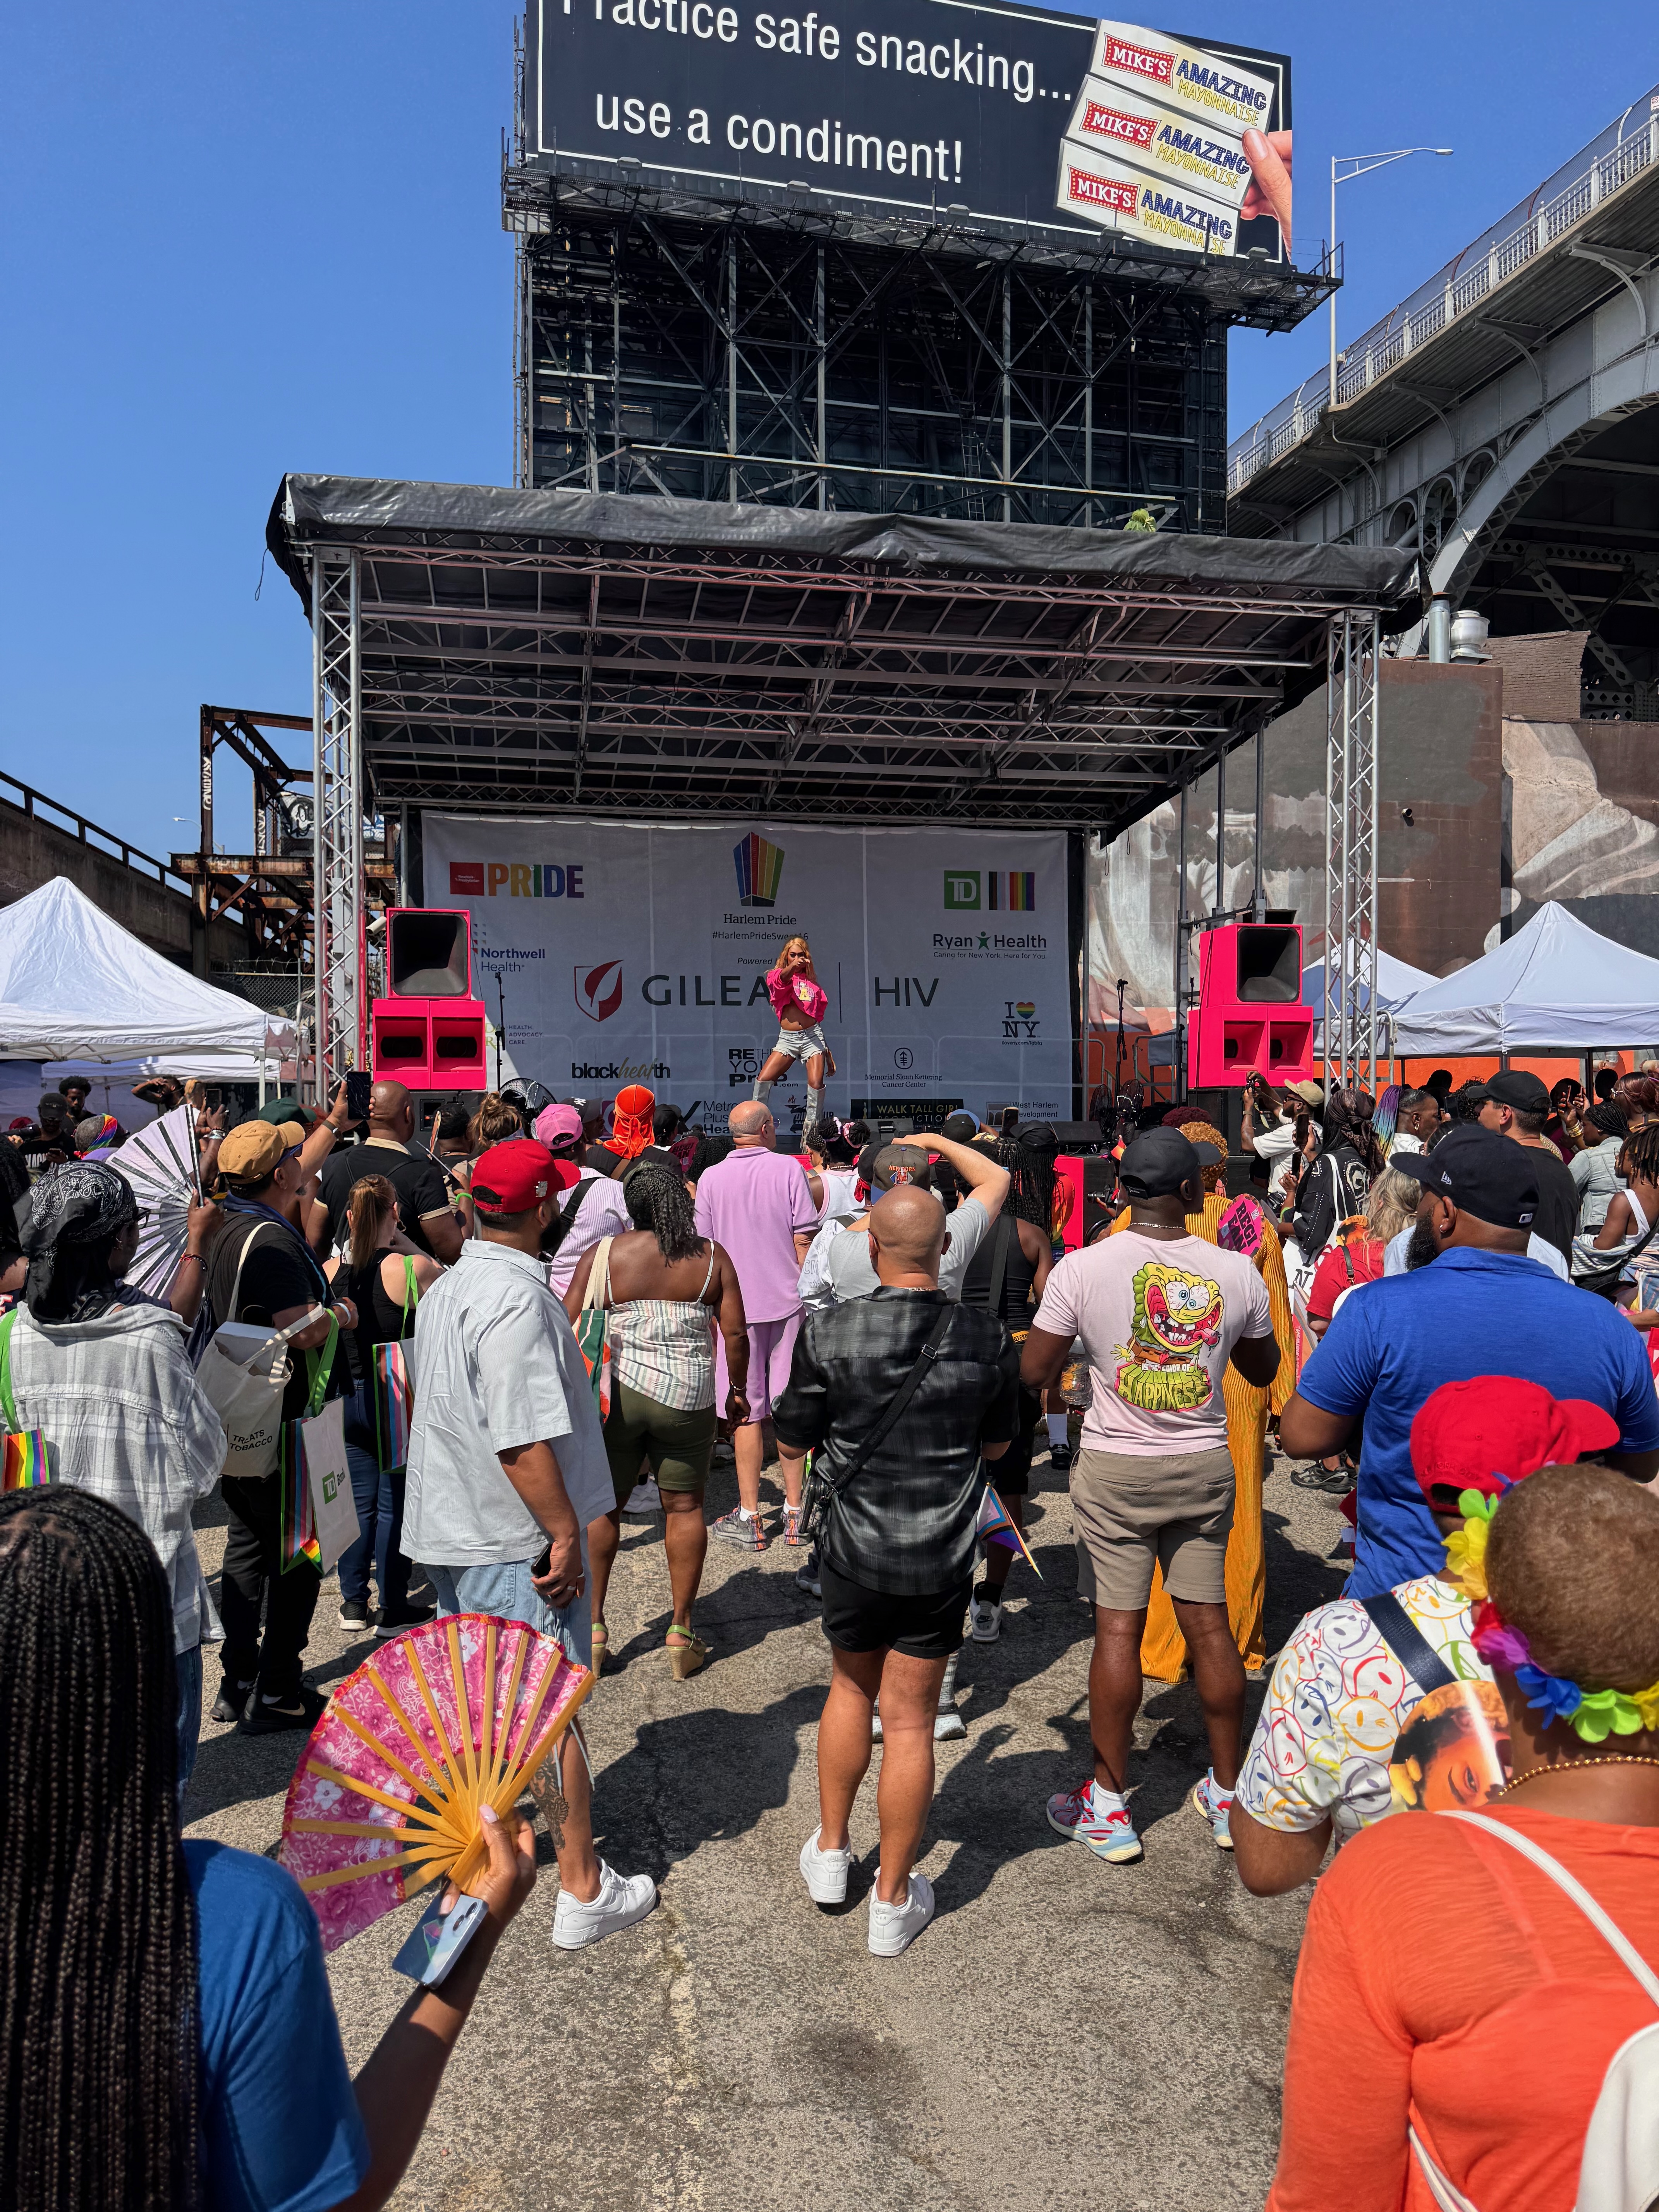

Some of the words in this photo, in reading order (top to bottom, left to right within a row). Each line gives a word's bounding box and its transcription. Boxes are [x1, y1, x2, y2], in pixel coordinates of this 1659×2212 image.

[564, 0, 738, 42] actice
[756, 13, 840, 60] safe
[856, 31, 1071, 103] snacking...
[1113, 45, 1168, 76] MIKE'S
[1176, 58, 1267, 111] AMAZING
[1178, 79, 1261, 126] MAYONNAISE
[597, 94, 671, 138] use
[688, 108, 711, 145] a
[727, 115, 961, 184] condiment!
[1091, 111, 1149, 142] MIKE'S
[1156, 124, 1250, 175] AMAZING
[1156, 144, 1241, 190] MAYONNAISE
[1077, 177, 1133, 208] MIKE'S
[1141, 189, 1232, 240] AMAZING
[488, 863, 584, 898] PRIDE
[948, 878, 977, 902] TD
[723, 914, 766, 924] Harlem
[767, 915, 797, 925] Pride
[481, 948, 546, 959] Northwell
[933, 934, 973, 949] Ryan
[994, 934, 1047, 948] Health
[481, 961, 521, 972] Health
[642, 974, 770, 1006] GILEA
[875, 977, 939, 1007] HIV
[1005, 1002, 1015, 1018] I
[1002, 1021, 1040, 1038] NY
[704, 1113, 728, 1123] Plus
[876, 1105, 907, 1114] WALK
[910, 1105, 933, 1113] TALL
[230, 1435, 273, 1451] TOBACCO
[325, 1477, 336, 1497] TD
